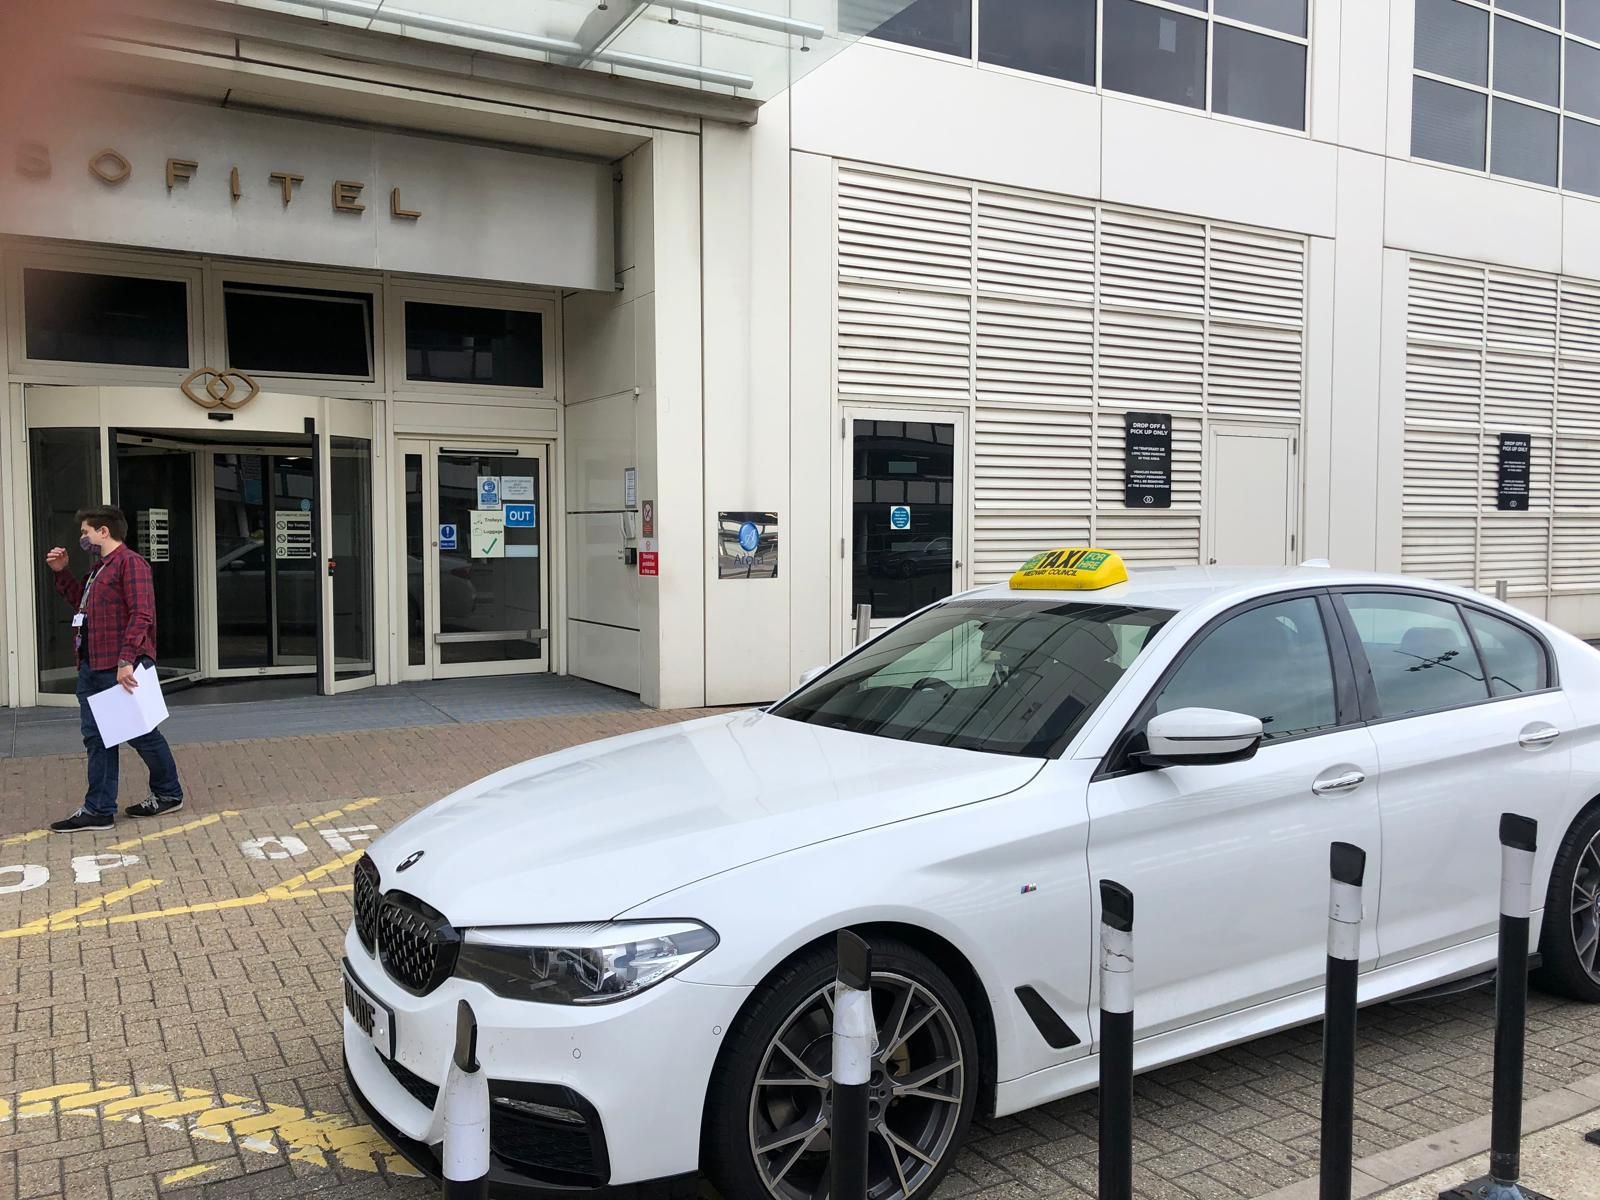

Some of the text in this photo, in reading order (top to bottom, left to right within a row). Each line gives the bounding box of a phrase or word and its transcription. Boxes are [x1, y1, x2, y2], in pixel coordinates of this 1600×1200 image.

[15, 142, 421, 220] SOFITEL
[510, 511, 531, 520] OUT
[1038, 550, 1089, 569] TAXI
[1087, 552, 1106, 561] FOR
[1078, 560, 1100, 570] HIRE
[1023, 568, 1078, 576] MEDWAY COUNCIL
